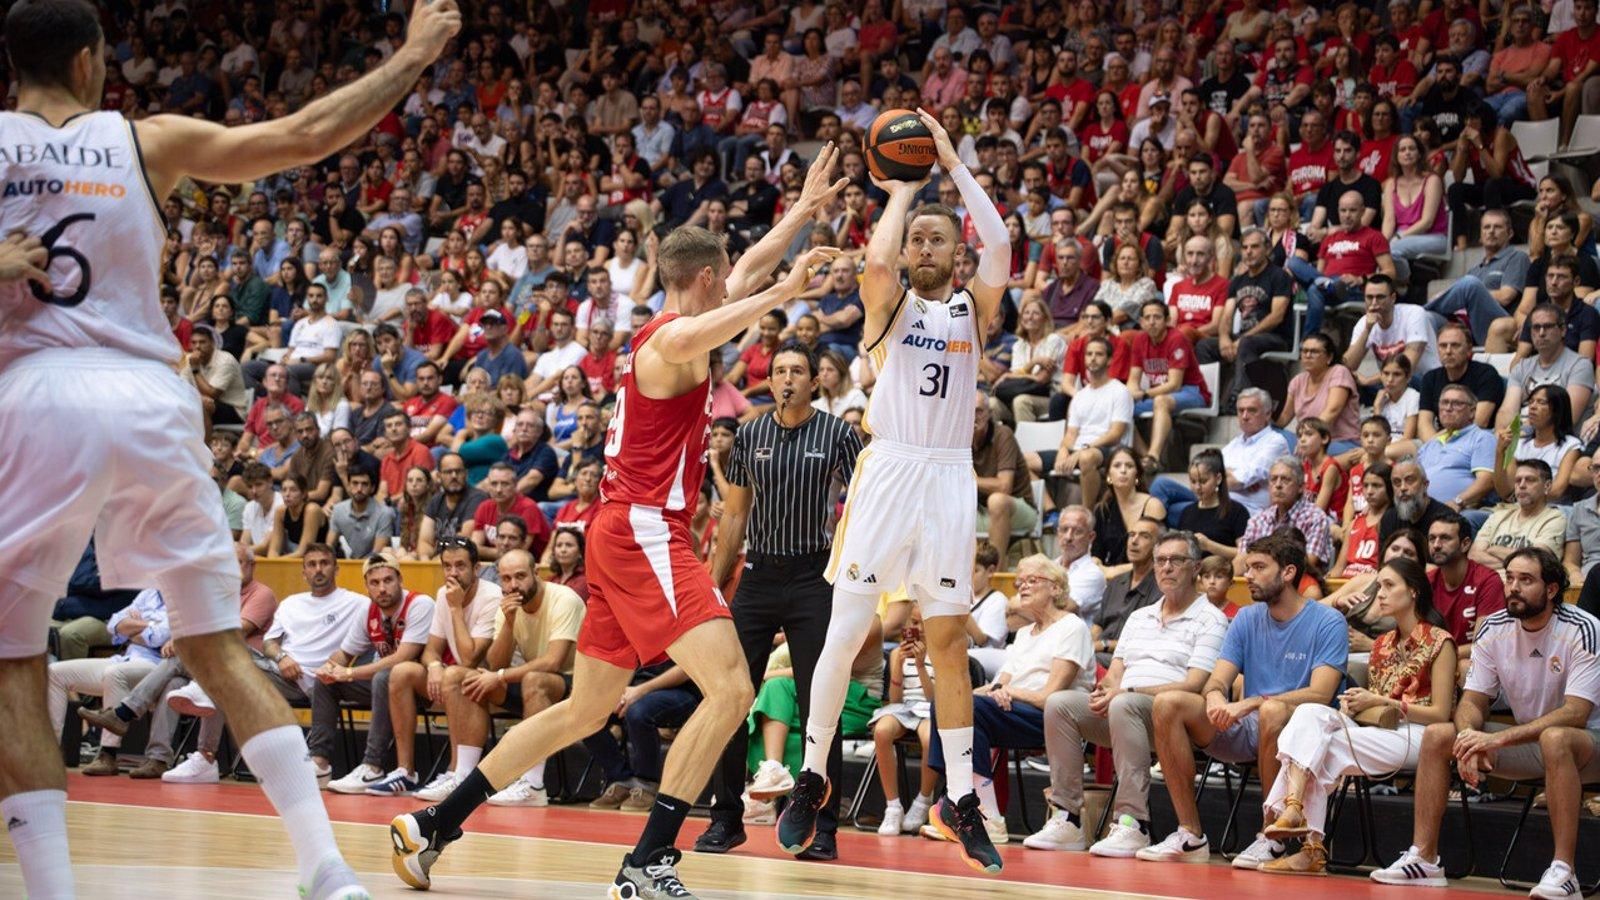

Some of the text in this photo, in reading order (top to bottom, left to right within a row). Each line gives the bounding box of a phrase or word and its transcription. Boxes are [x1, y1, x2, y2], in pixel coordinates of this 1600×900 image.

[4, 178, 126, 198] AUTOHERO
[28, 213, 96, 308] 6
[919, 363, 950, 399] 31
[1355, 539, 1376, 559] 10
